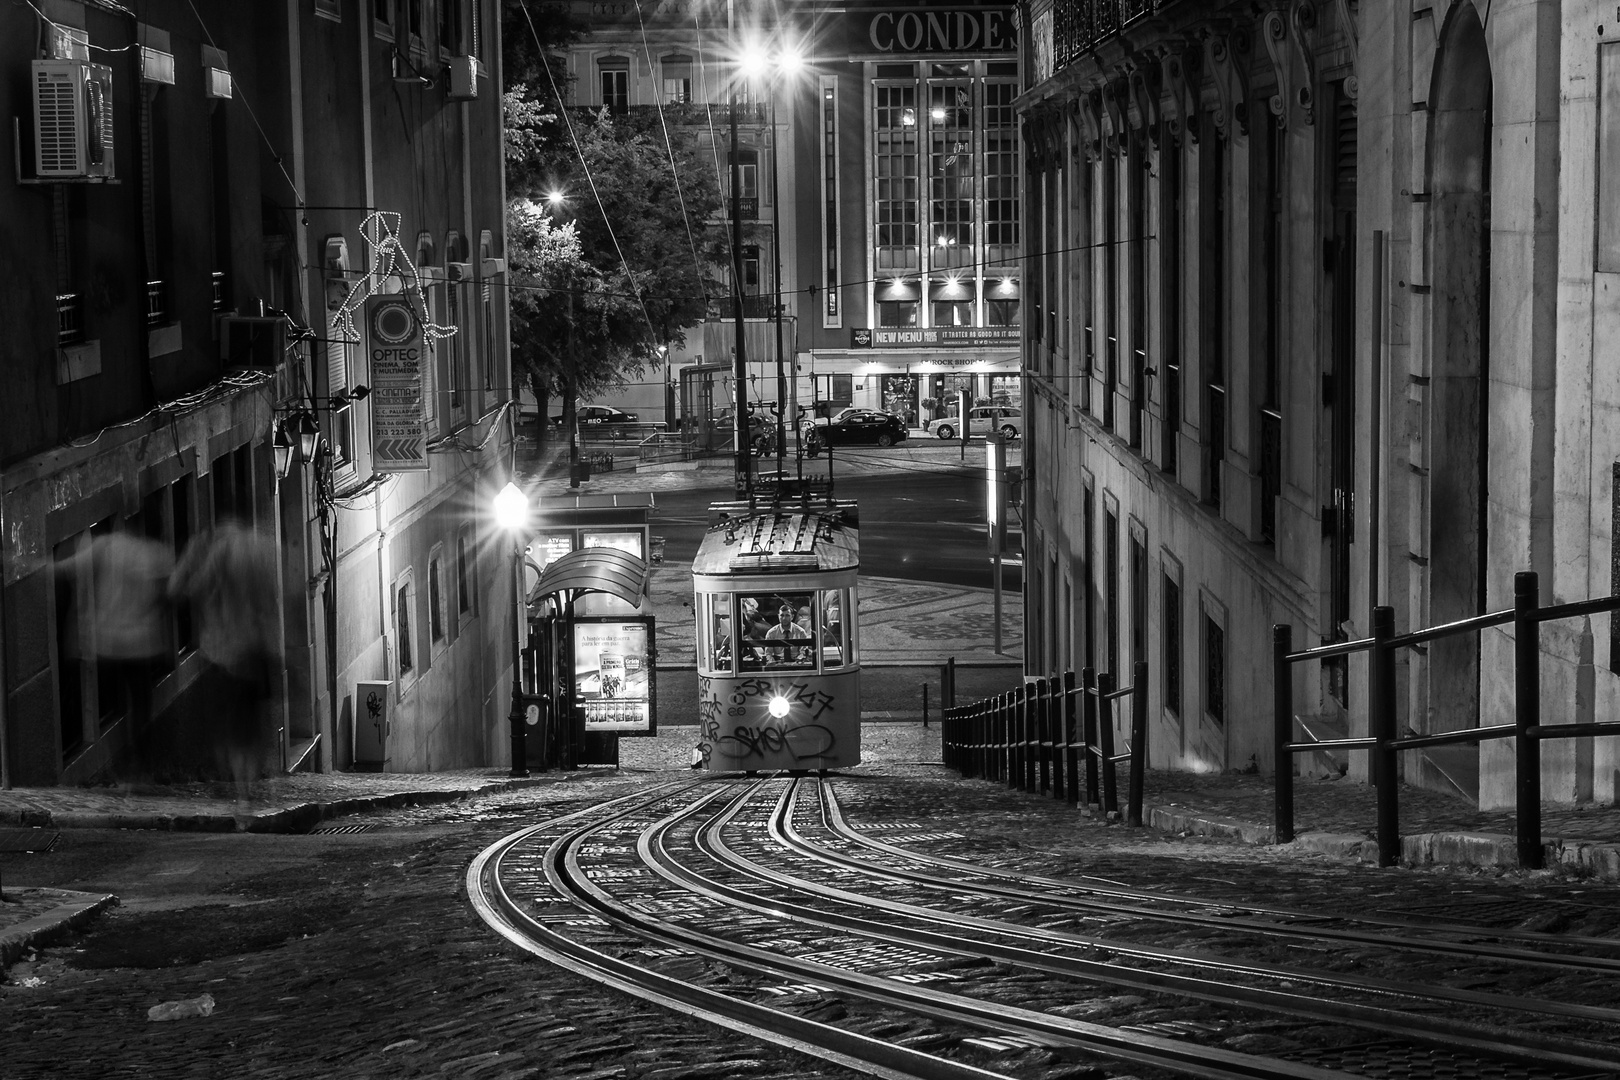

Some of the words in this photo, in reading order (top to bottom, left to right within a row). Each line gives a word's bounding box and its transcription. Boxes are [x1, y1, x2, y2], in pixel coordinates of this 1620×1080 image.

[876, 332, 896, 343] NEW
[897, 331, 922, 343] MENU
[373, 349, 418, 361] OPTEC
[381, 388, 411, 396] CINEMA
